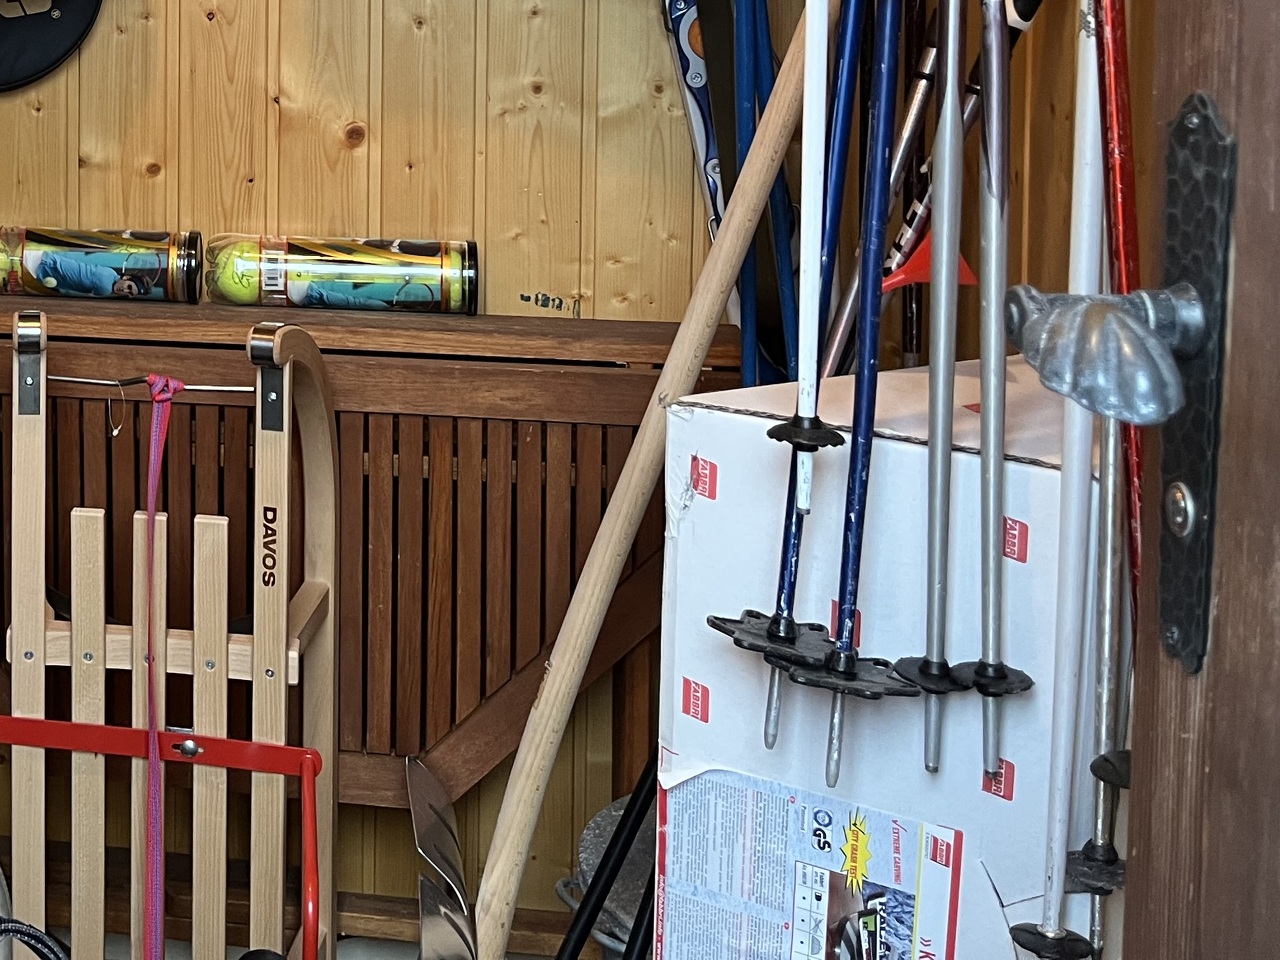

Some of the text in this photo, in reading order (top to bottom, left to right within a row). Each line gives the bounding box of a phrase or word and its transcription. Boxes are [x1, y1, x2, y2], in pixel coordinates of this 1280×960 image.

[262, 506, 277, 588] DAVOS
[812, 827, 832, 852] GS
[892, 827, 901, 856] EXTREME
